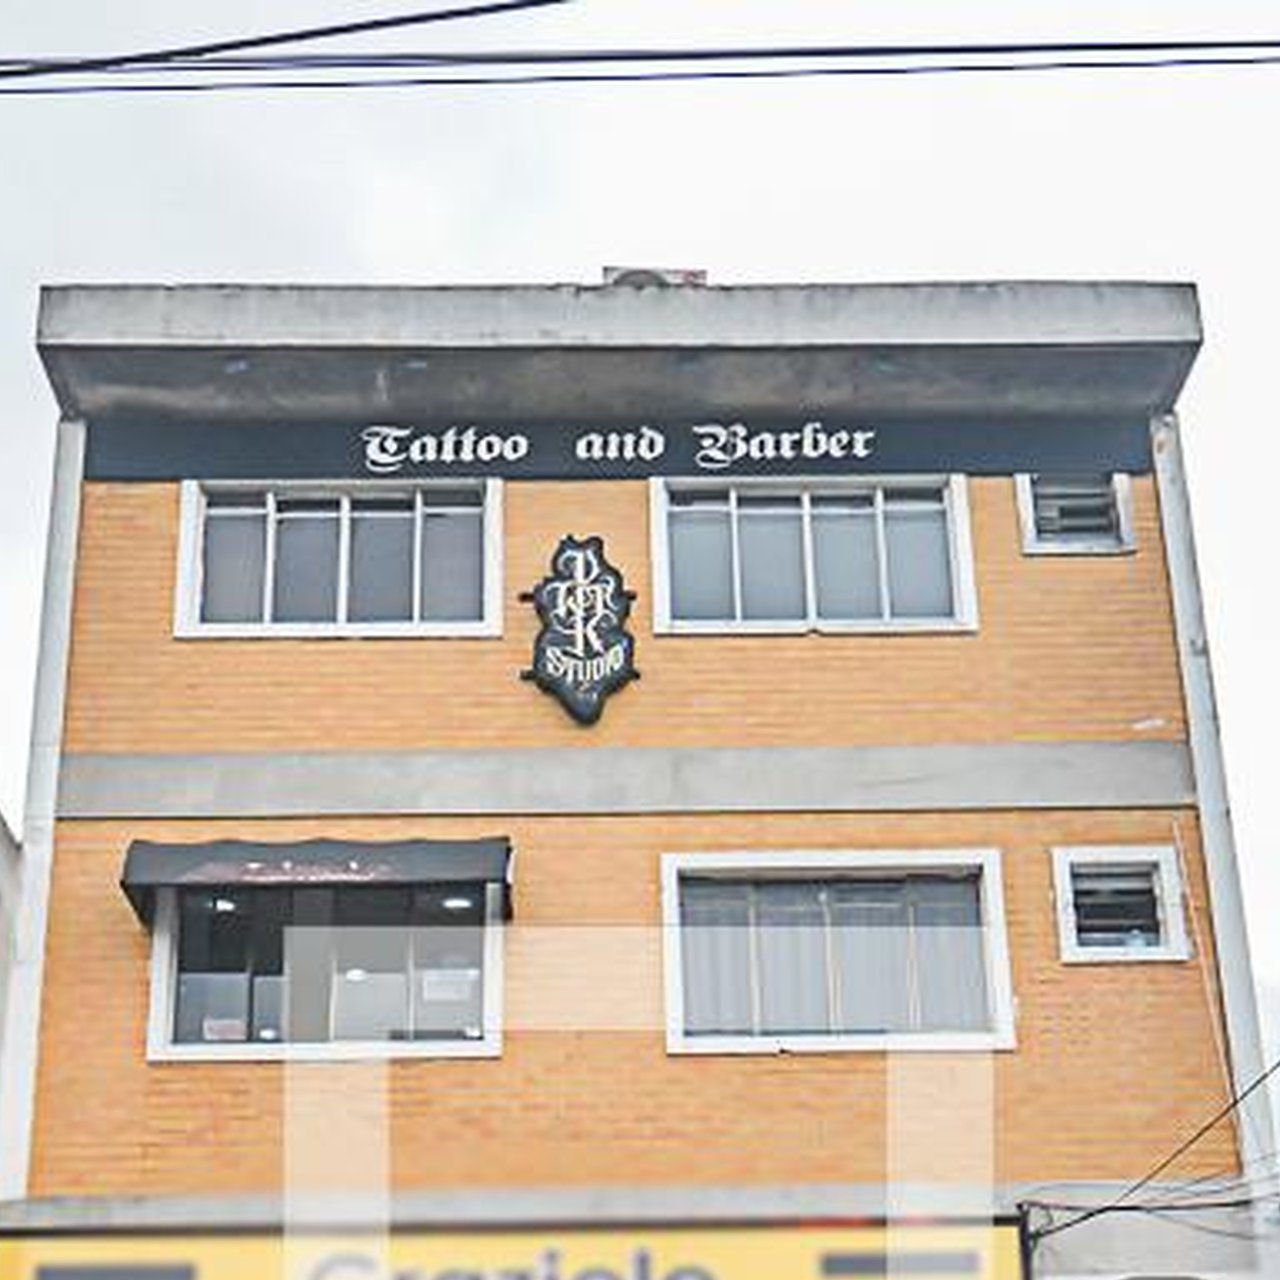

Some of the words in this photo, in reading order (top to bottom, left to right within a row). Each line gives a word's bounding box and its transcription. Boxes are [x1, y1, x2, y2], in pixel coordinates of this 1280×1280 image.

[360, 425, 528, 471] Tattoo
[575, 426, 665, 461] and
[692, 423, 874, 468] Barber
